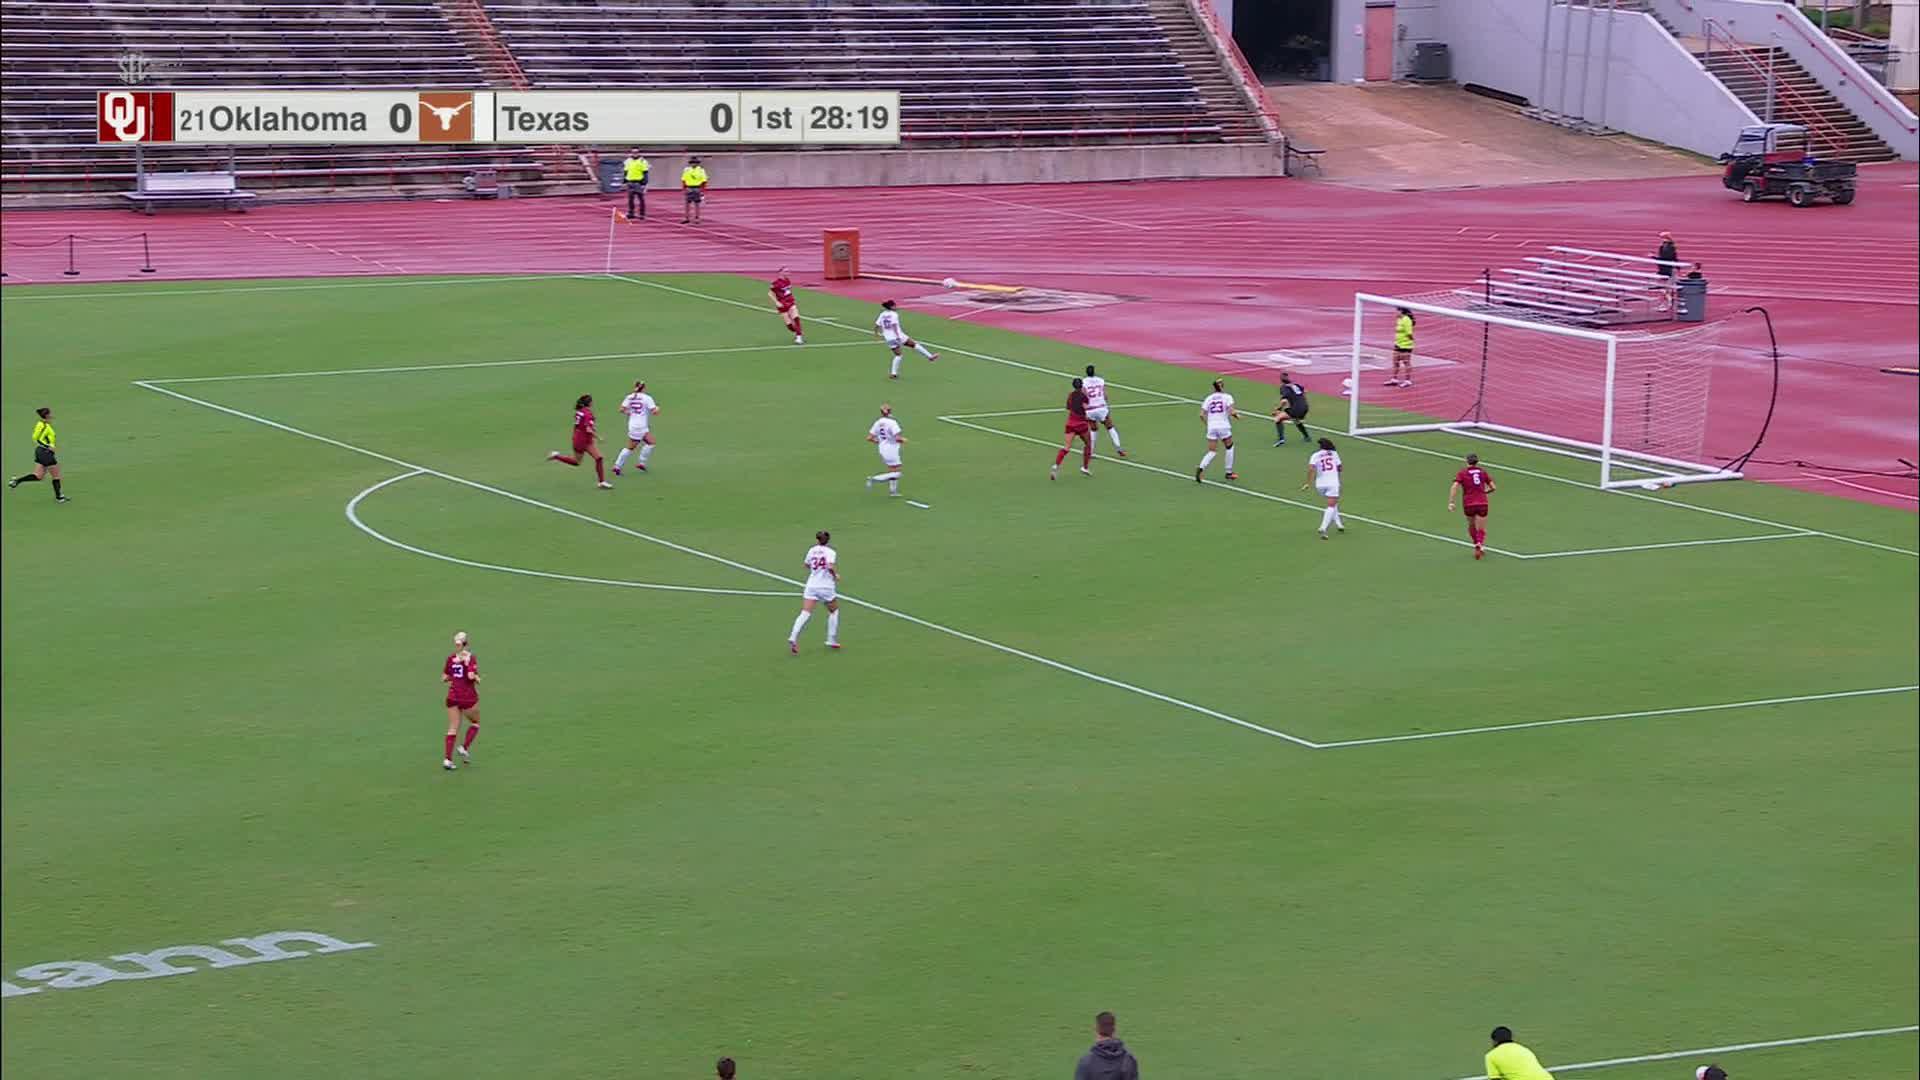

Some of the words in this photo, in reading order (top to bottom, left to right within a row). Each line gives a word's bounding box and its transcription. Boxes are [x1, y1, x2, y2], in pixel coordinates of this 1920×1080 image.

[1208, 401, 1224, 414] 23
[1320, 457, 1334, 472] 15
[810, 556, 827, 570] 34
